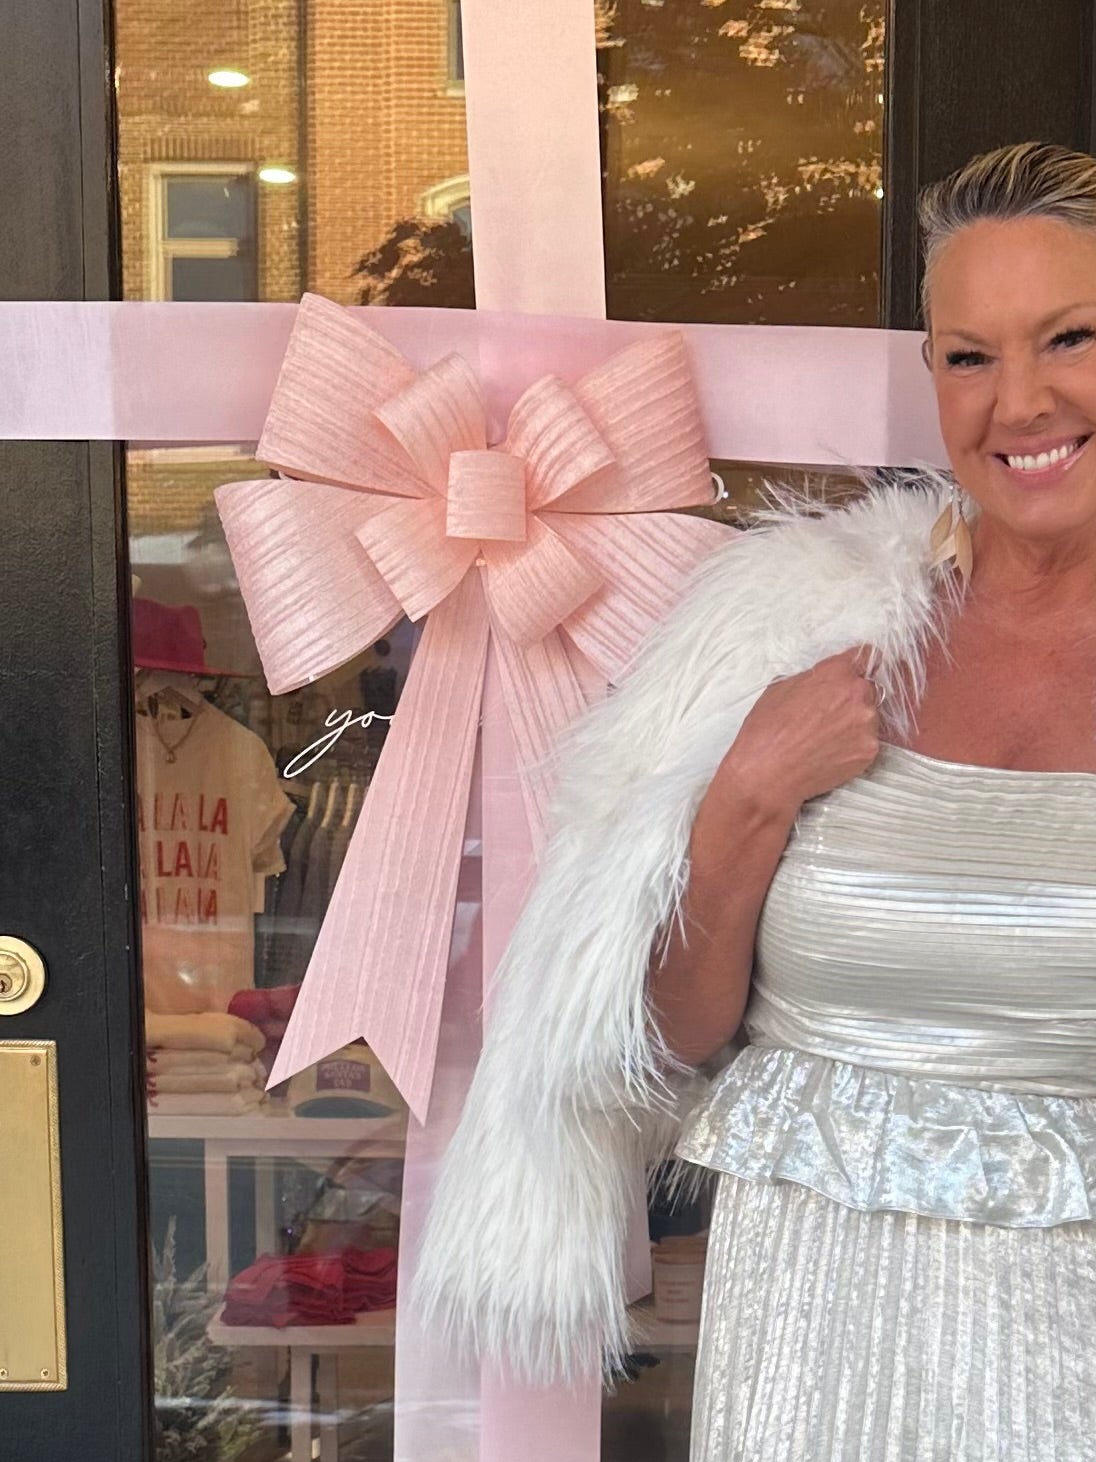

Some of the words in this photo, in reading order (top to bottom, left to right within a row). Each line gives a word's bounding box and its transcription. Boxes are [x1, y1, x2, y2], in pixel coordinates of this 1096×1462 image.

[283, 708, 396, 779] yo
[198, 793, 229, 835] LA
[156, 840, 194, 878] LA
